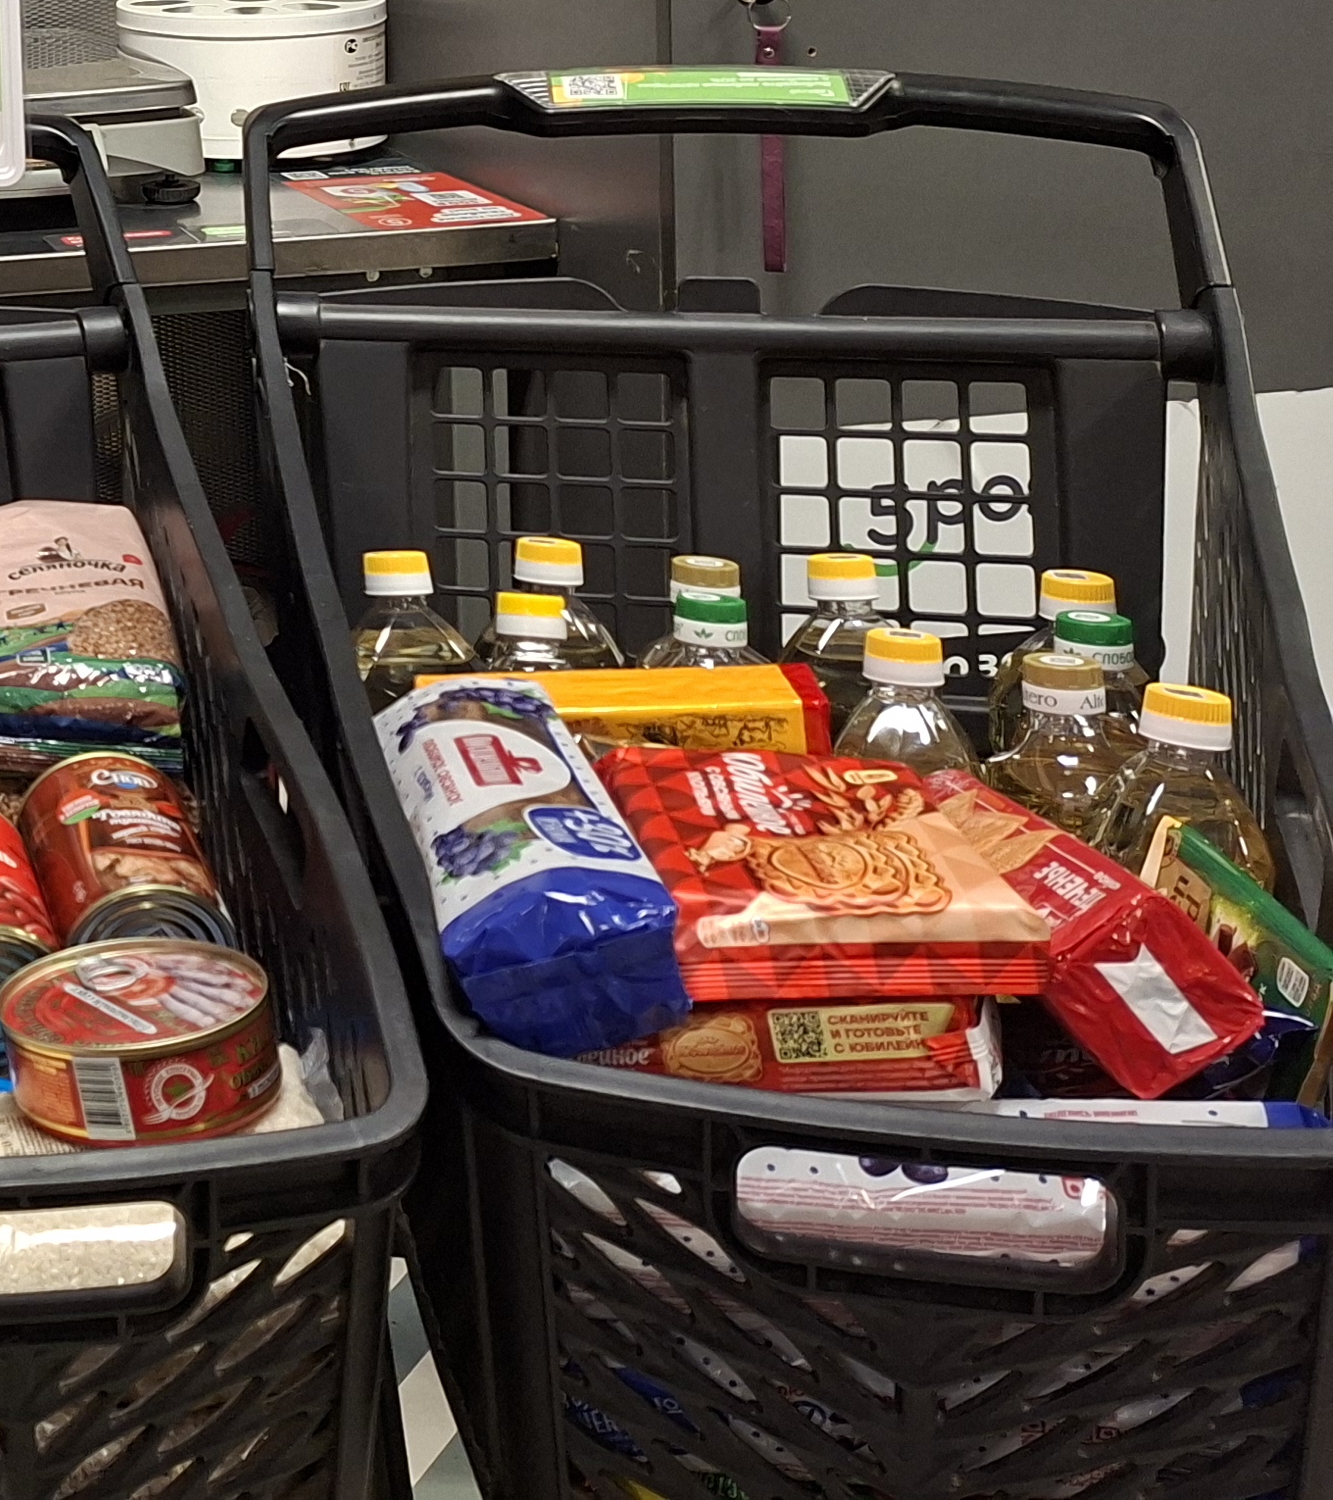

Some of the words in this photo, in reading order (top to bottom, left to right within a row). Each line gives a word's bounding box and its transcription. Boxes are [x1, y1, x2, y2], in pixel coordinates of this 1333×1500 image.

[8, 560, 127, 581] селяночка
[1032, 860, 1108, 917] ПЕЧЕНЬЕ
[827, 1009, 930, 1026] СКАНИРУЙТЕ
[830, 1029, 842, 1040] И
[844, 1024, 922, 1040] ГОТОВЬТЕ
[833, 1042, 845, 1054] С
[848, 1038, 927, 1054] ЮБИЛЕЙН
